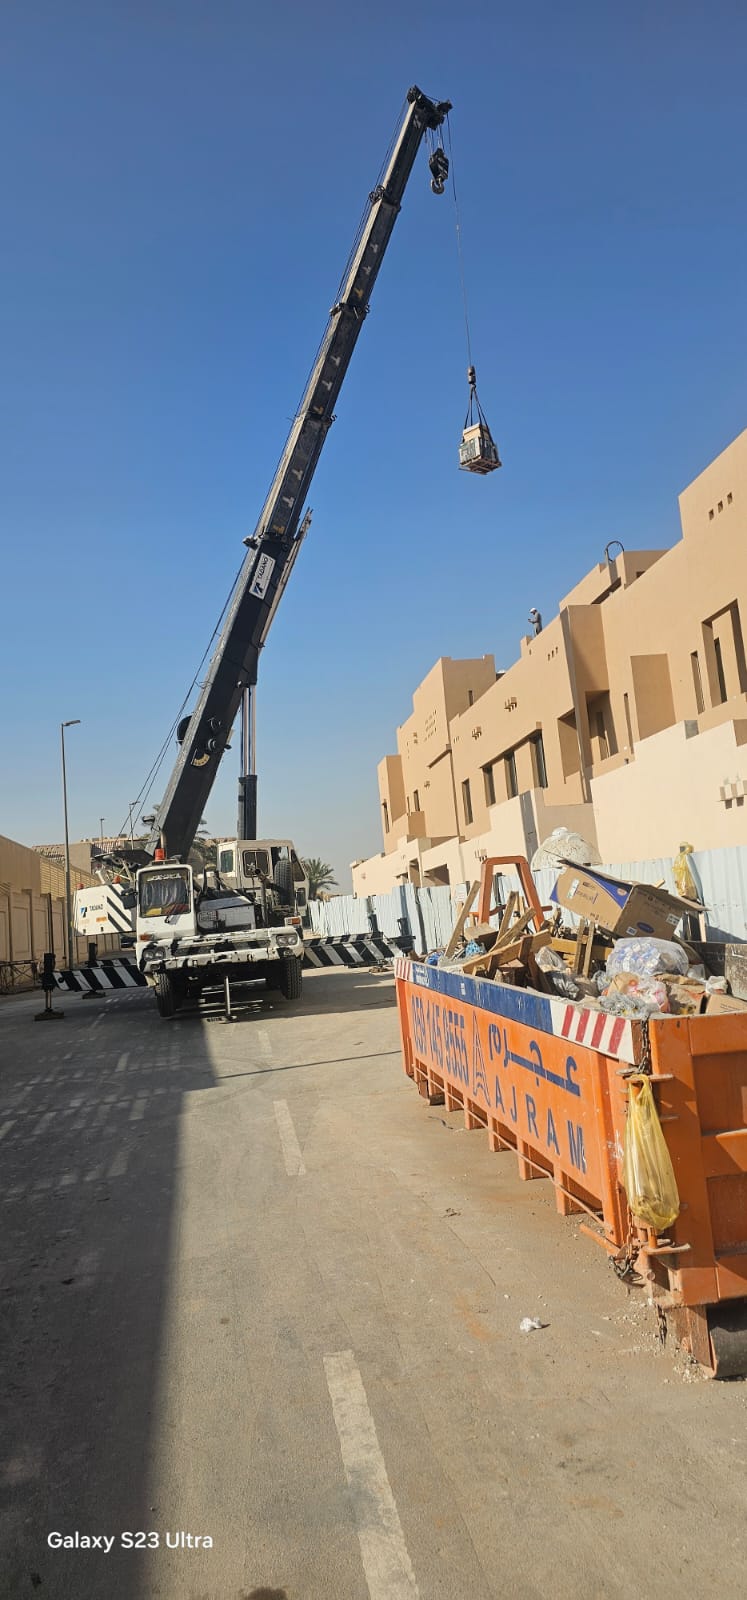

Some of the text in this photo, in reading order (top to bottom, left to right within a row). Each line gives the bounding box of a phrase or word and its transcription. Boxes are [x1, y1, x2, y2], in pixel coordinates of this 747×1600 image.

[427, 1000, 443, 1070] 145
[443, 1007, 470, 1088] 9555
[495, 1075, 587, 1174] AJRAM
